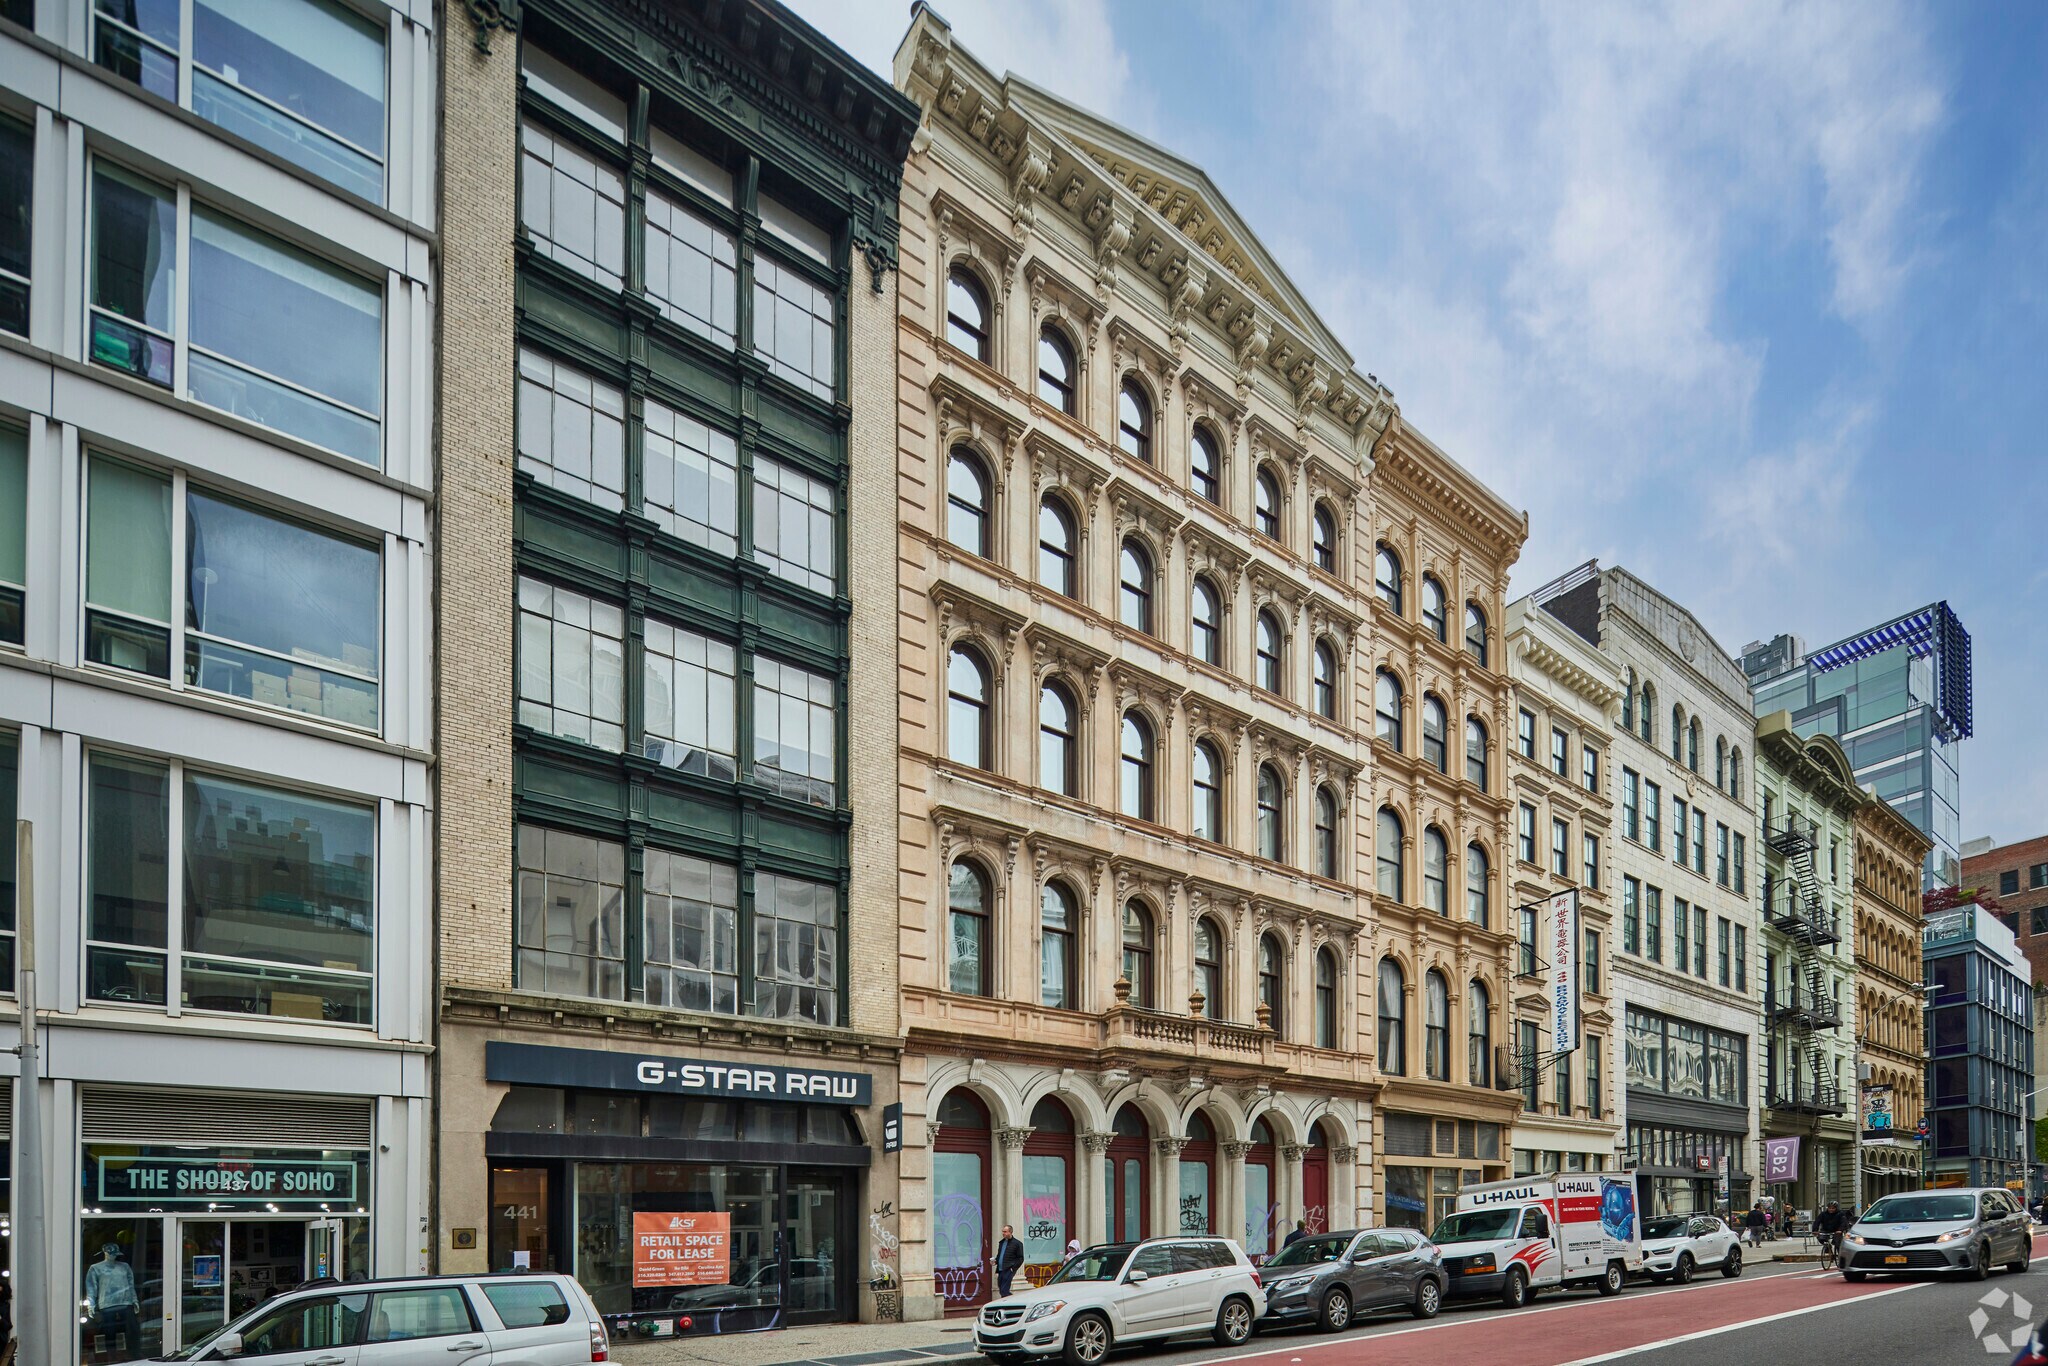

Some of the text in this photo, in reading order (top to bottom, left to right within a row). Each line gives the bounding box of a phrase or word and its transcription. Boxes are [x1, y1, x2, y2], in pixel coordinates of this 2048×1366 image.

[637, 1061, 857, 1098] G-STAR RAW
[1772, 1145, 1788, 1174] CB2
[127, 1169, 335, 1191] THE SHOPS OF SOHO
[222, 1181, 250, 1191] 437
[504, 1205, 537, 1219] 441
[641, 1235, 724, 1246] RETAIL SPACE
[649, 1248, 714, 1260] FOR LEASE
